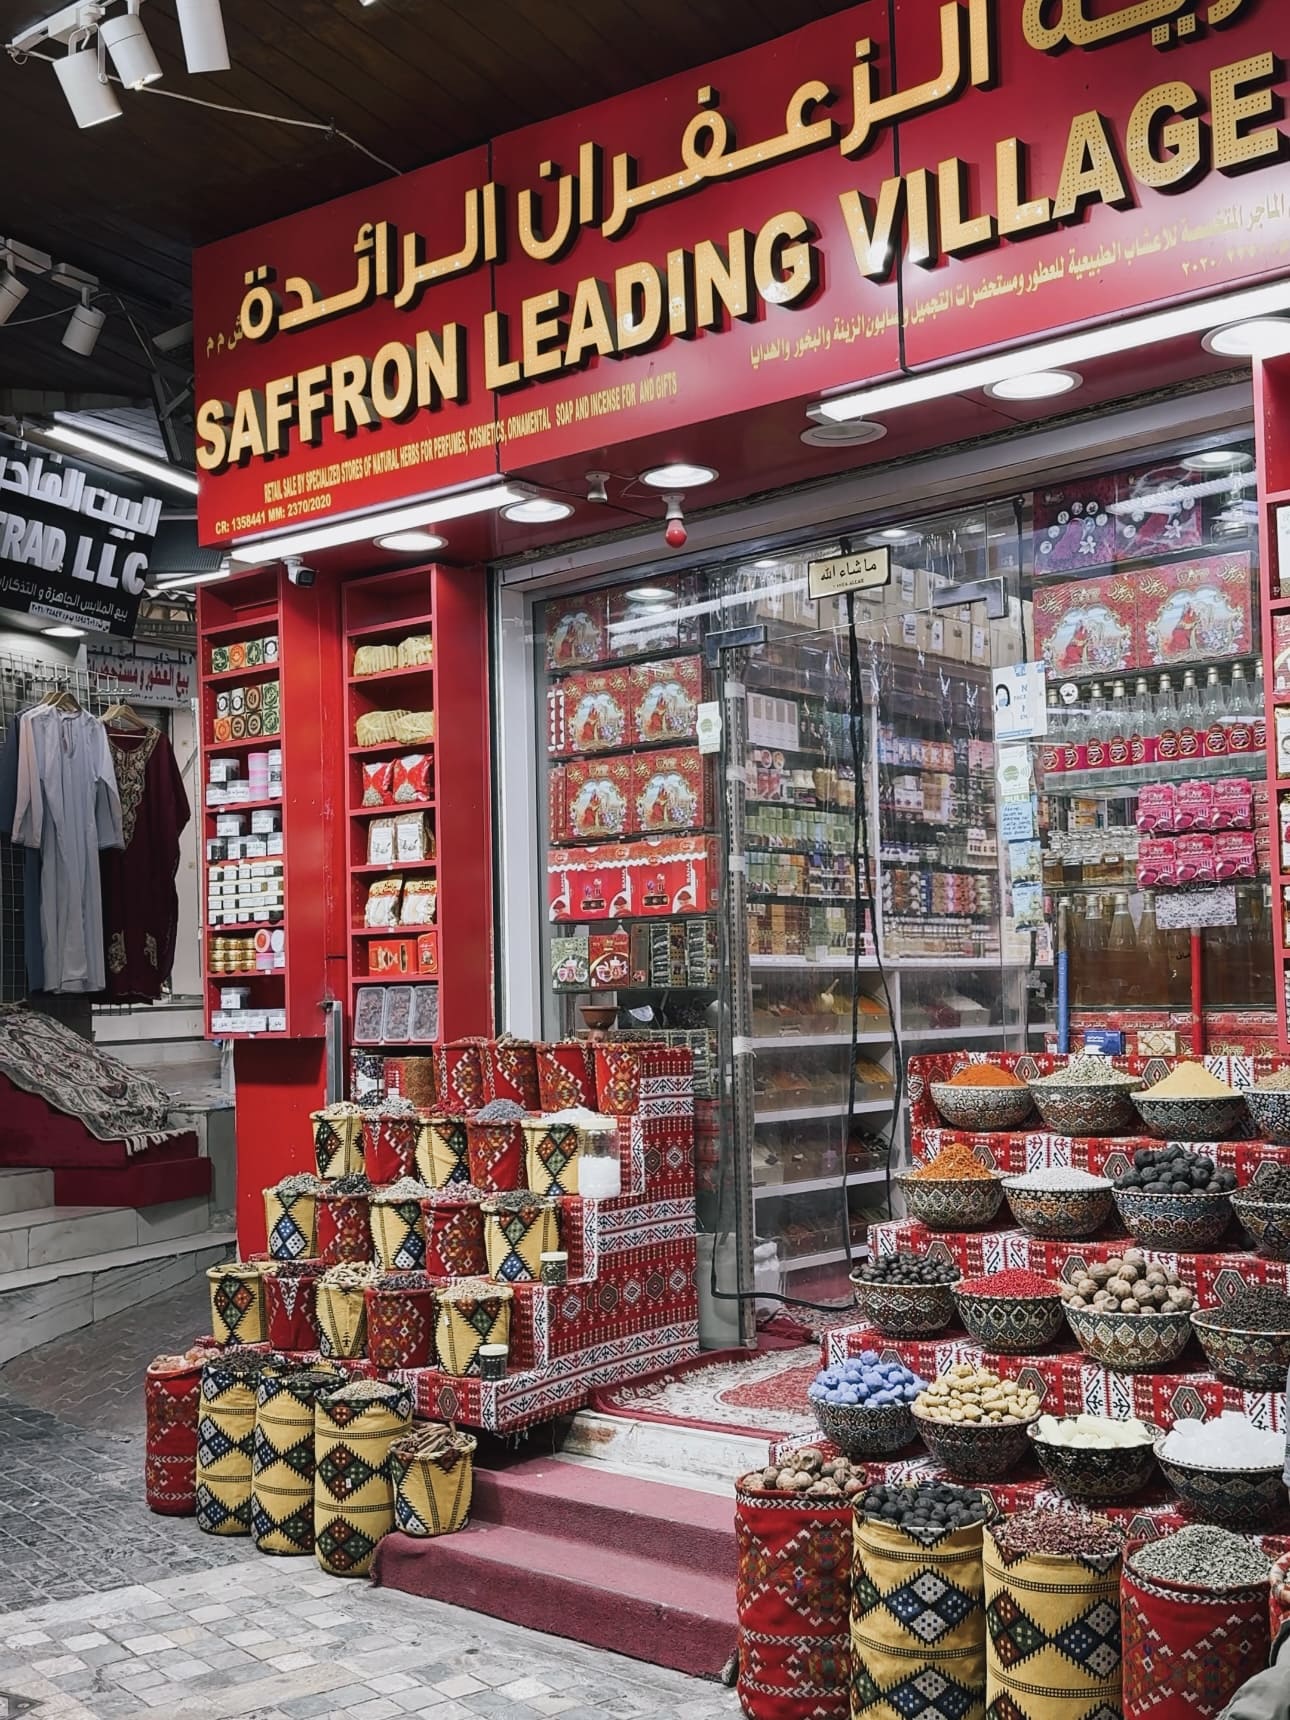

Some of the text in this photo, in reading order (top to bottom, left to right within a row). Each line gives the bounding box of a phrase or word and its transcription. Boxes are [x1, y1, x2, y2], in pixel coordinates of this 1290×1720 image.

[240, 0, 990, 341] الزعفران الرائدة
[196, 50, 1280, 471] SAFFRON LEADING VILLAGE
[264, 480, 283, 503] RETAIL
[283, 476, 298, 499] SALE
[306, 465, 341, 493] SPECIALIZED
[341, 458, 364, 484] STORES
[364, 457, 373, 477] OF
[372, 450, 400, 475] NATURAL
[399, 444, 420, 469] HERBS
[420, 441, 433, 463] FOR
[507, 407, 552, 438] ORNAMENTAL
[555, 401, 575, 427] SOAP
[575, 397, 590, 421] AND
[591, 387, 621, 417] INCENSE
[621, 382, 637, 409] FOR
[639, 377, 655, 404] AND
[656, 371, 678, 400] GIFTS
[81, 486, 163, 542] البيت
[215, 518, 231, 535] CR:
[268, 506, 286, 522] MM:
[286, 493, 332, 518] 2370/2020
[72, 535, 149, 596] LLC
[820, 558, 877, 581] ما شاء الله
[38, 588, 44, 601] و
[45, 586, 81, 608] الجاهزة
[80, 600, 115, 616] الملابس
[114, 607, 129, 623] بيع
